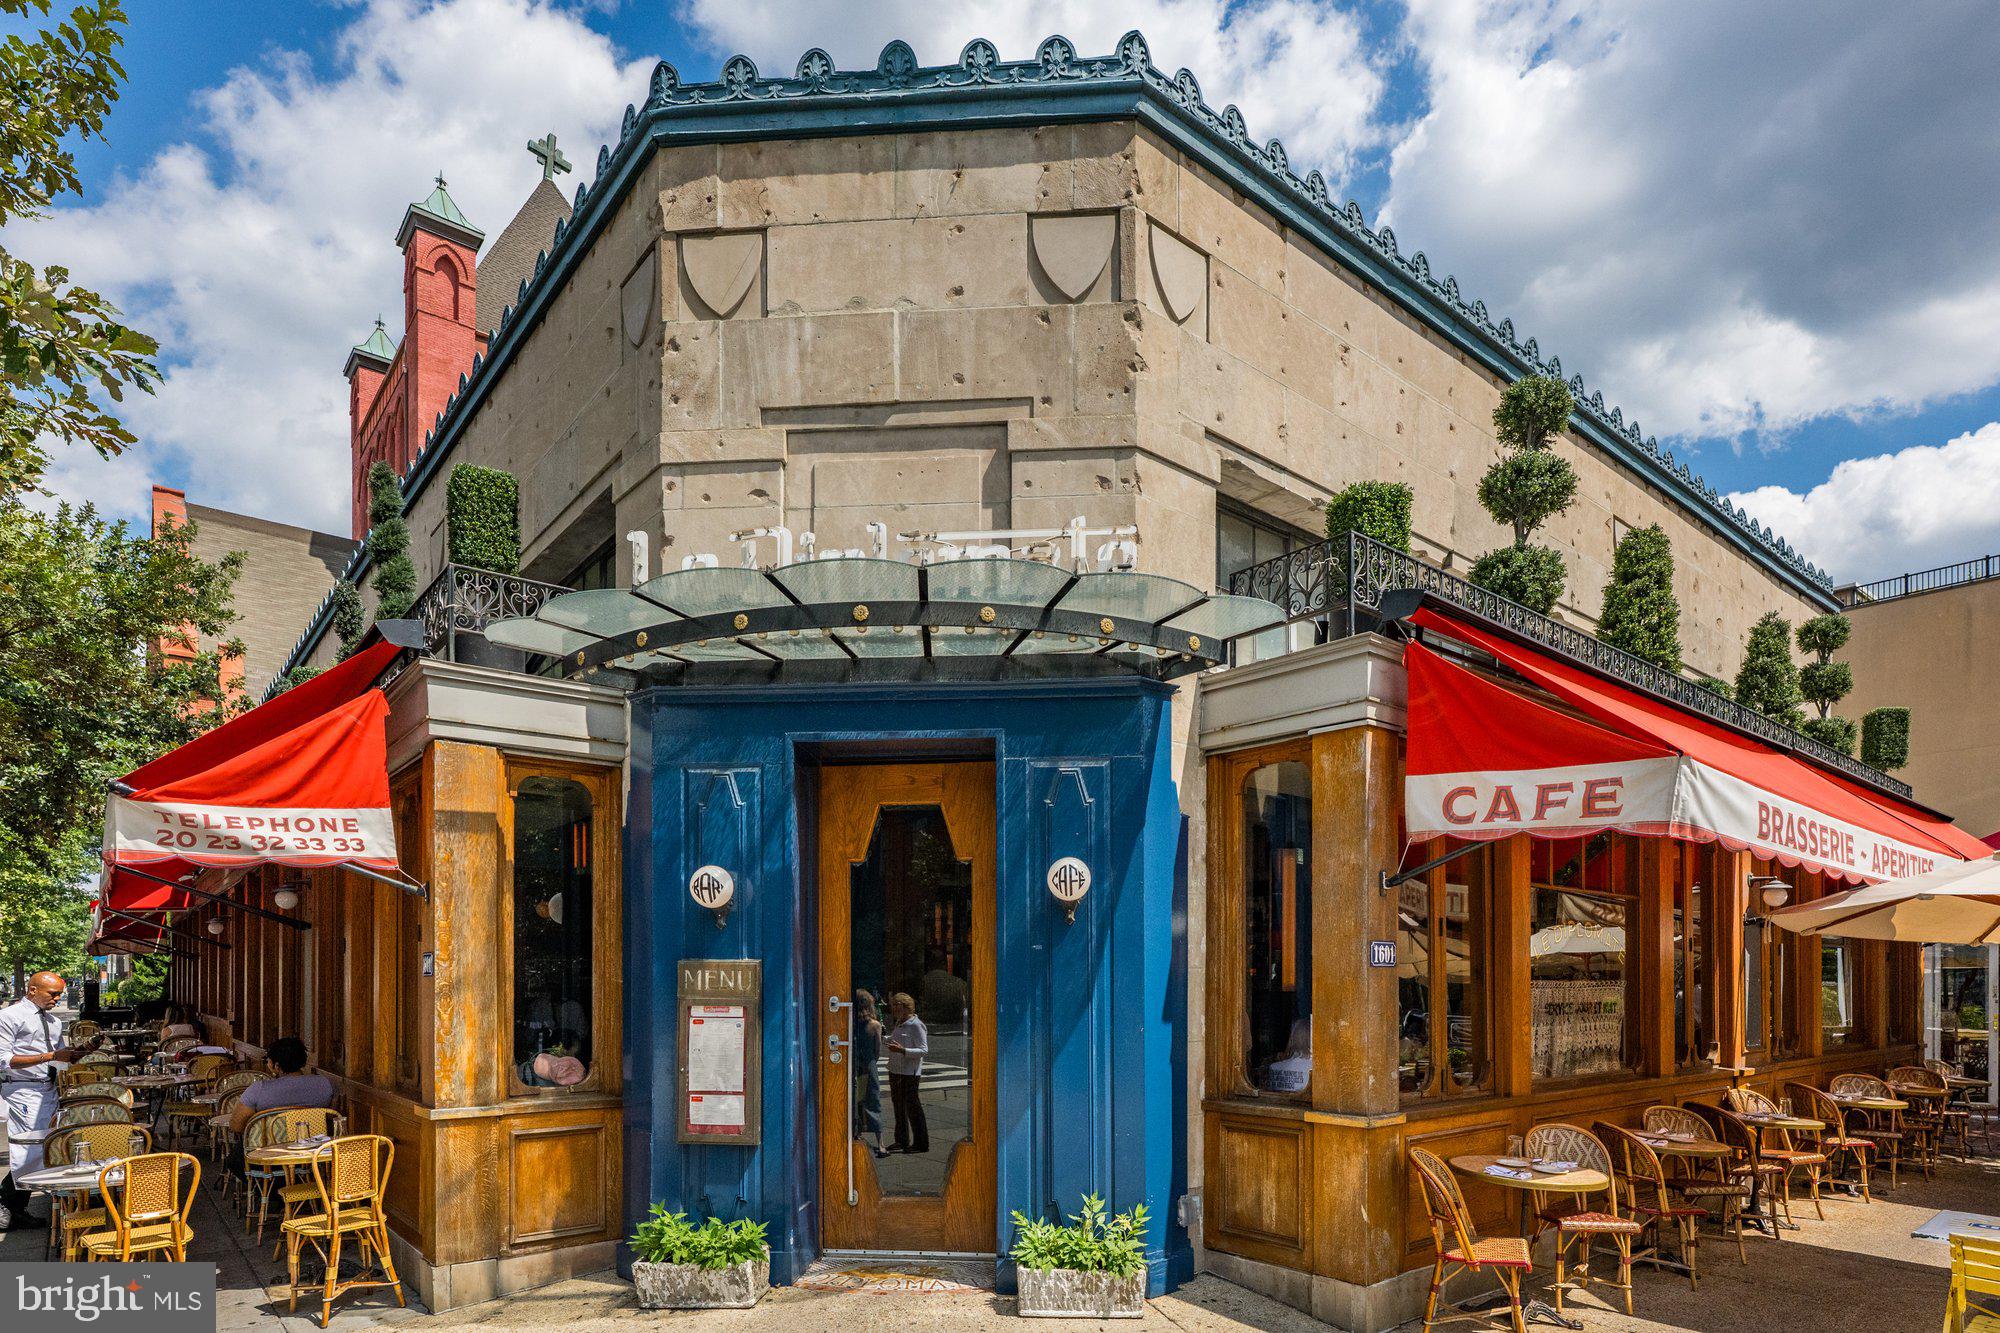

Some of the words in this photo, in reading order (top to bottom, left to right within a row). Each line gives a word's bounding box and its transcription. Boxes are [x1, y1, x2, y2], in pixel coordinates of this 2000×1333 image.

[1442, 777, 1624, 825] CAFE
[153, 810, 359, 833] TELEPHONE
[156, 829, 197, 848] 20
[205, 834, 242, 850] 23
[251, 834, 286, 851] 32
[293, 837, 327, 852] 33
[333, 837, 366, 852] 33
[1757, 801, 1855, 866] BRASSERIE
[693, 872, 721, 904] BAR
[1373, 944, 1395, 963] 1601
[684, 969, 752, 991] MENU
